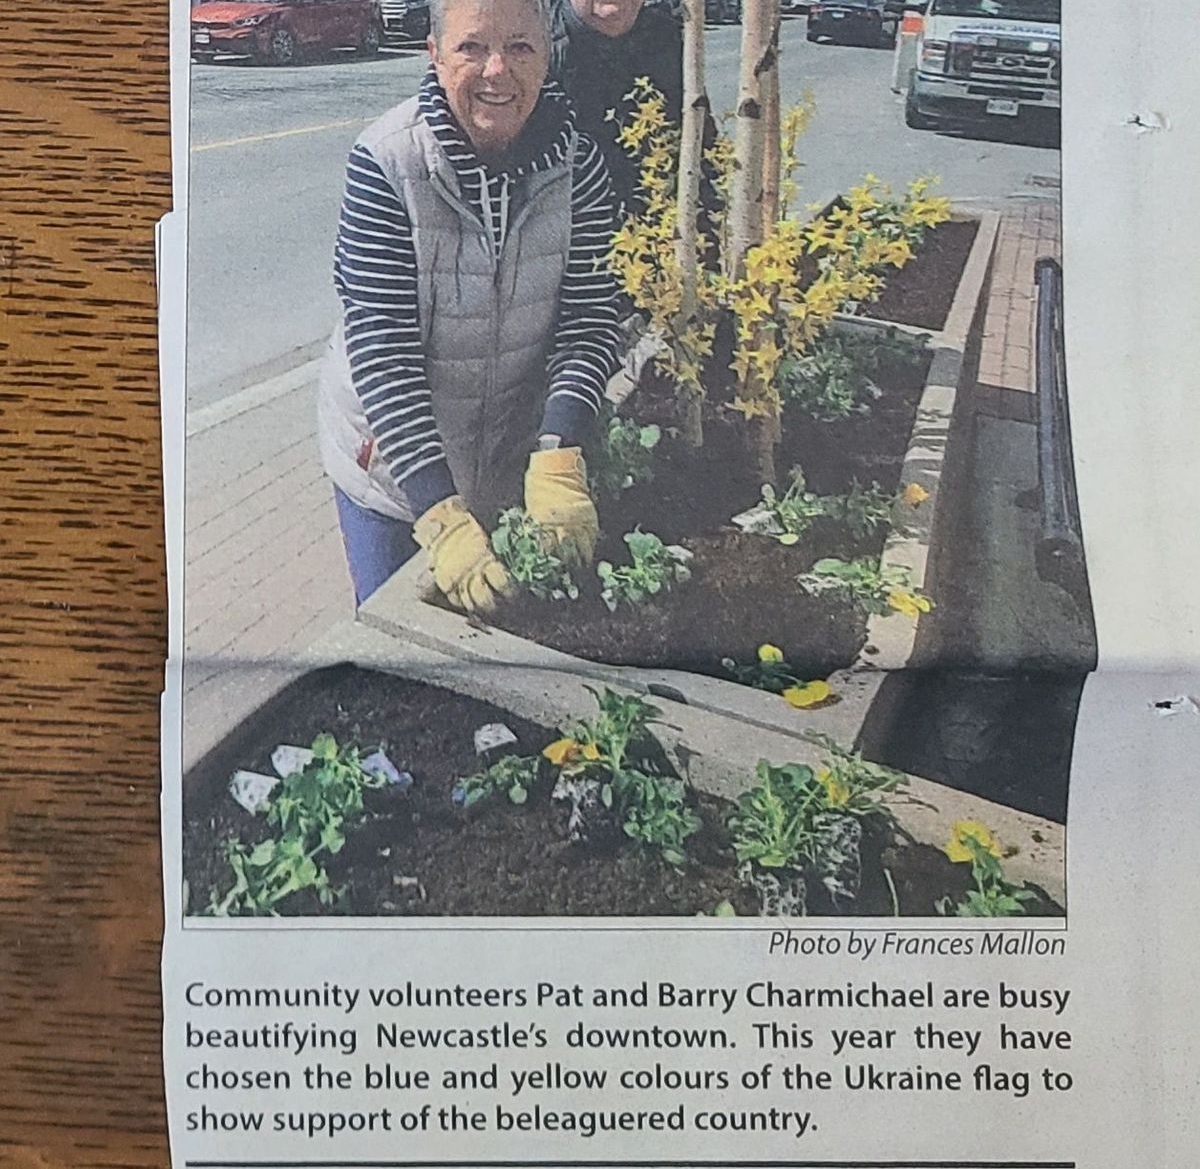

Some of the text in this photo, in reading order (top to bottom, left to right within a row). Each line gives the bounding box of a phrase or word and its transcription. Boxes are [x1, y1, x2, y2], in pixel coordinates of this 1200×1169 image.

[768, 931, 1066, 961] Photo by Frances Mallon
[186, 981, 1070, 1016] Community volunteers Pat and Barry Charmichael are busy
[186, 1021, 356, 1056] beautifying
[566, 1021, 736, 1049] downtown.
[752, 1022, 813, 1050] This
[831, 1030, 896, 1056] year
[914, 1022, 981, 1057] they
[1000, 1023, 1071, 1050] have
[186, 1062, 1073, 1097] chosen the blue and yellow colours of the Ukraine flag to
[187, 1104, 817, 1138] show support of the beleaguered country.
